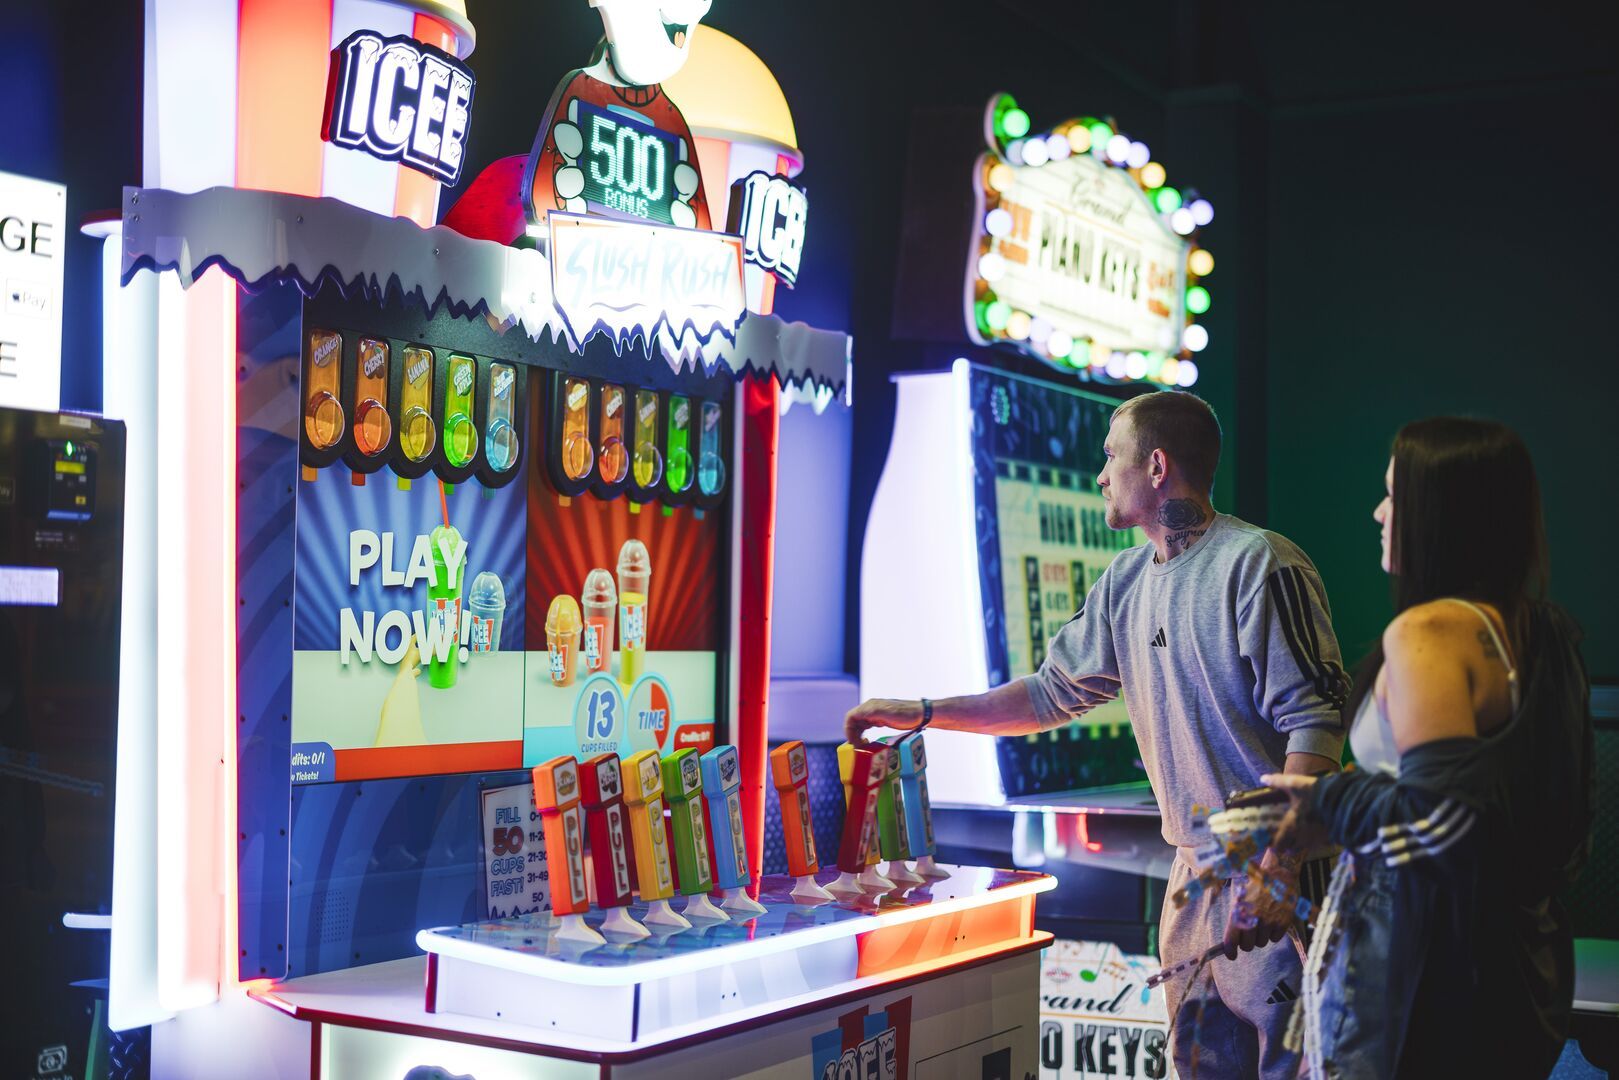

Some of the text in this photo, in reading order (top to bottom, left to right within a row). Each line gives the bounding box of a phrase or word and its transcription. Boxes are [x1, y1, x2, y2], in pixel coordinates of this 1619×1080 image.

[338, 36, 474, 177] ICEE
[590, 115, 665, 201] 500
[604, 187, 649, 219] BONUS
[0, 216, 52, 258] GE
[565, 237, 735, 308] SLUSH RUSH
[313, 336, 338, 365] ORANGE
[363, 349, 385, 376] CHERRY
[350, 529, 469, 590] PLAY
[340, 608, 472, 666] NOW!
[587, 688, 616, 739] 13
[638, 709, 665, 731] TIME
[311, 751, 326, 765] 0/1
[581, 741, 618, 753] CUPS FILLED
[296, 770, 319, 782] Tickets!
[495, 806, 521, 825] FILL
[492, 825, 525, 857] 50
[566, 815, 583, 898] PULL
[609, 811, 627, 891] PULL
[651, 805, 668, 885] PULL
[691, 803, 709, 878] PULL
[491, 856, 525, 876] CUPS
[527, 870, 549, 883] 31-49
[490, 876, 525, 898] FAST!
[532, 892, 544, 903] 50
[1074, 1022, 1167, 1080] KEYS
